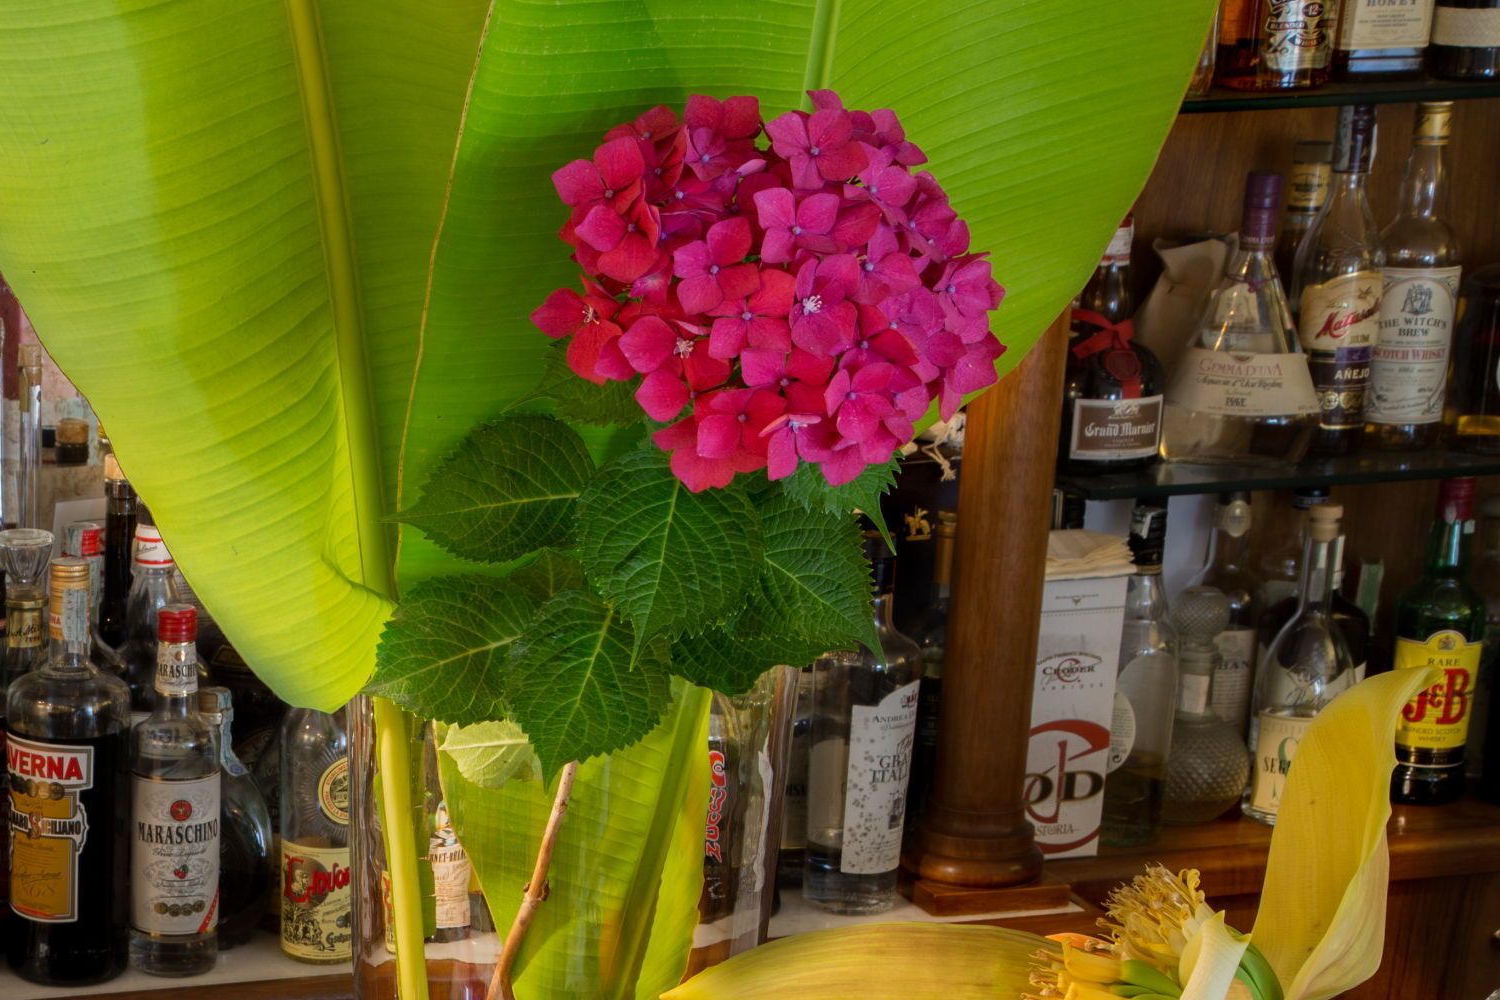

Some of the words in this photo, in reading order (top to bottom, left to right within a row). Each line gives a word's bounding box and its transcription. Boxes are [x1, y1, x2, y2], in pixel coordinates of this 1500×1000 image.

[1315, 297, 1381, 340] Matusal
[1379, 318, 1401, 330] THE
[1404, 316, 1448, 329] WITCH'S
[1398, 327, 1430, 337] BREW
[1373, 348, 1409, 361] SCOTCH
[1411, 348, 1446, 361] WHISKY
[1200, 358, 1243, 376] GEMMA
[1334, 367, 1370, 380] AÑEJO
[1084, 421, 1120, 438] Grand
[1121, 421, 1156, 437] Marnier
[156, 662, 197, 679] ARASCHI
[1428, 657, 1461, 667] RARE
[1402, 667, 1469, 726] J&B
[872, 713, 910, 725] ANDREA
[879, 754, 909, 771] GRA
[28, 810, 82, 838] SICILIANO
[137, 817, 218, 845] MARASCHINO
